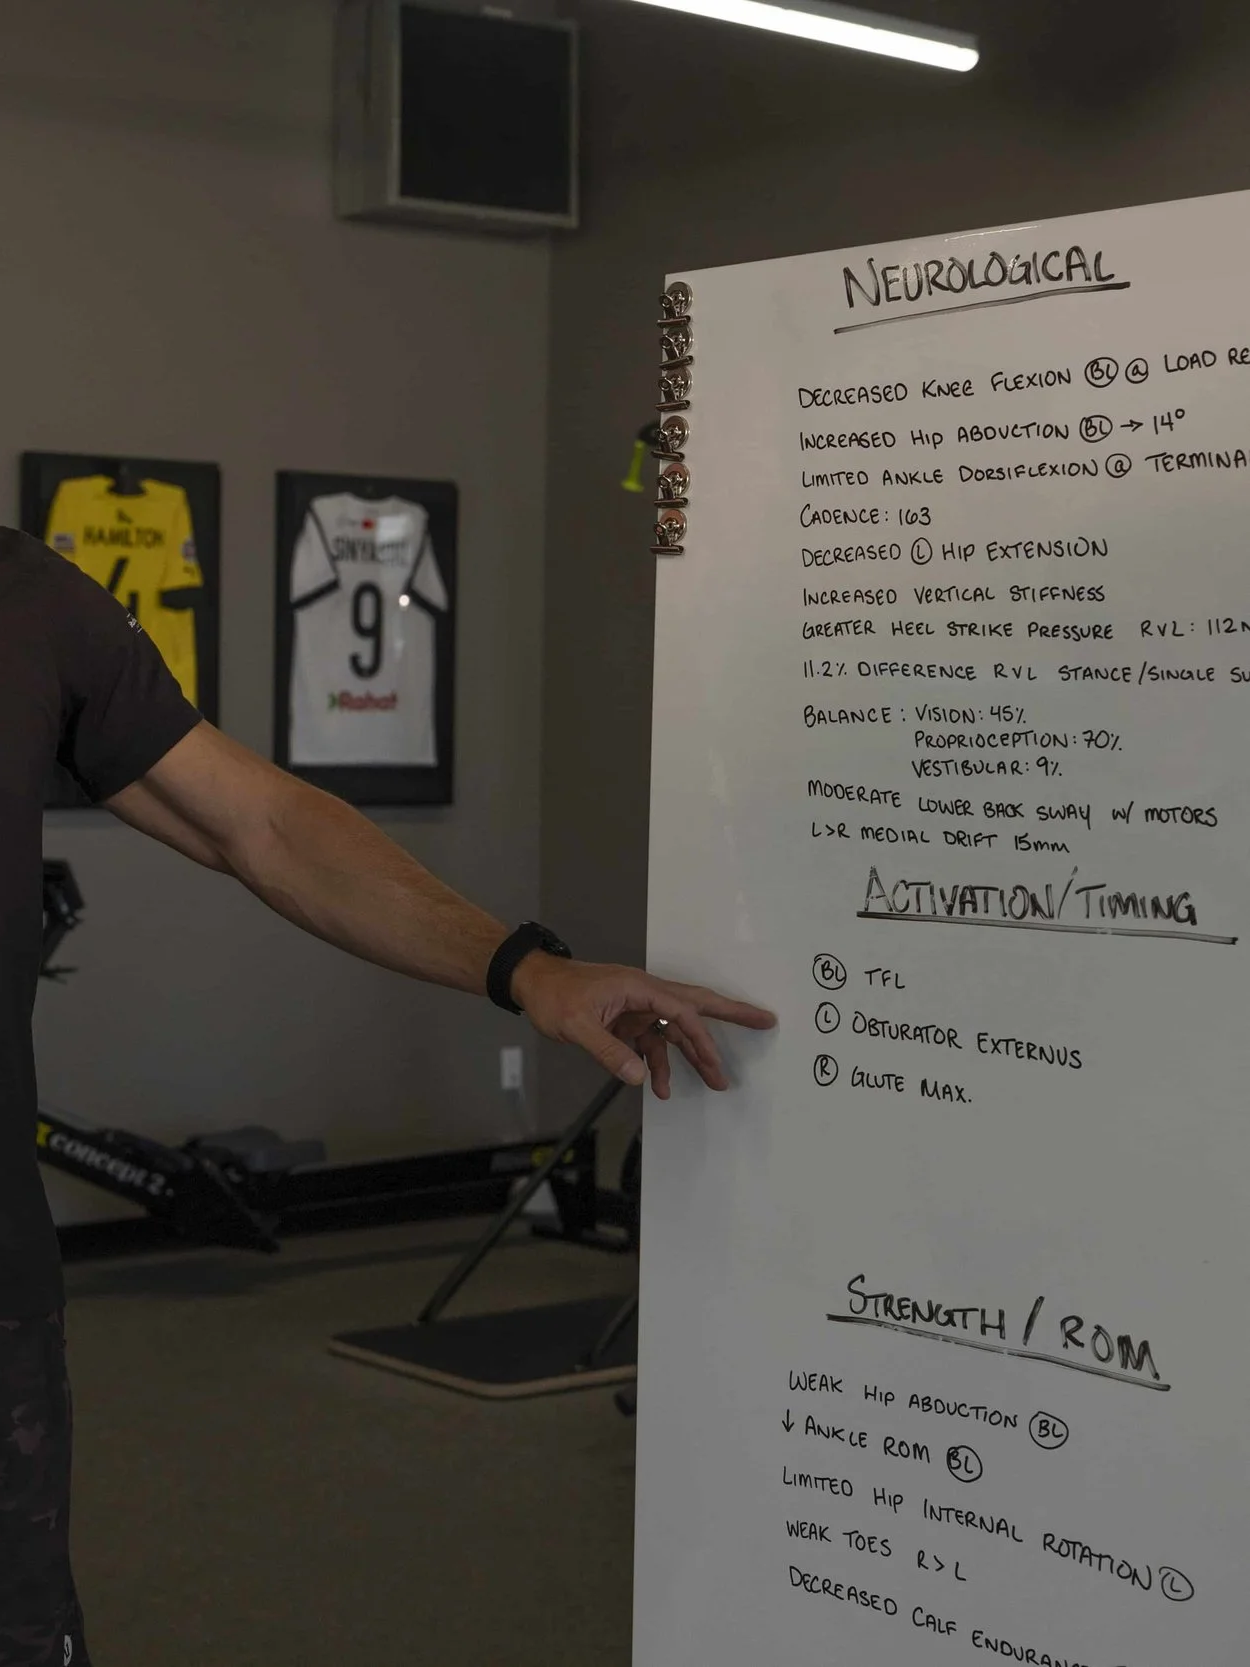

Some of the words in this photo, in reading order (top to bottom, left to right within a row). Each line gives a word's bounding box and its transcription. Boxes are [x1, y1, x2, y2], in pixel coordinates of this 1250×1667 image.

[843, 246, 1114, 308] NEUROLOGICAL
[797, 382, 909, 409] DECREASED
[921, 378, 975, 399] KNEE
[990, 367, 1072, 393] FLEXION
[1163, 349, 1218, 374] LOAD
[799, 431, 897, 452] INCREASED
[910, 428, 944, 451] HIP
[957, 421, 1070, 444] ABDUCTION
[801, 470, 869, 489] LIMITED
[882, 468, 944, 487] ANKLE
[957, 458, 1099, 483] DORSIFLEXION
[898, 506, 932, 527] 163
[82, 525, 165, 548] HAMILTON
[801, 542, 902, 568] DECREASED
[941, 541, 976, 563] HIP
[985, 536, 1109, 563] EXTENSION
[802, 587, 898, 607] INCREASED
[913, 585, 996, 605] VERTICAL
[1008, 584, 1106, 604] STIFFNESS
[349, 580, 382, 680] 9
[802, 618, 877, 640] GREATER
[890, 619, 936, 637] HEEL
[946, 620, 1013, 638] STRIKE
[1026, 621, 1114, 643] PRESSURE
[803, 659, 848, 679] 11.2%
[857, 660, 978, 682] DIFFERENCE
[807, 779, 902, 809] MODERATE
[918, 796, 975, 817] LOWER
[982, 800, 1025, 819] BACK
[1035, 803, 1092, 831] SWAY
[1111, 800, 1135, 825] w/
[1143, 805, 1219, 828] MOTORS
[860, 825, 931, 845] MEDIAL
[942, 829, 999, 849] DRIFT
[1013, 832, 1071, 854] 15mm
[863, 967, 906, 990] TFL
[851, 1010, 963, 1050] OBTURATOR
[976, 1031, 1083, 1070] EXTERNUS
[850, 1065, 905, 1093] GLUTE
[920, 1077, 973, 1104] MAX.
[847, 1274, 1006, 1340] STRENGTH
[1060, 1315, 1160, 1381] ROM
[788, 1369, 844, 1394] WEAK
[863, 1384, 896, 1408] HIP
[908, 1393, 1019, 1429] ABDUCTION
[804, 1414, 868, 1449] ANKLE
[883, 1435, 931, 1464] ROM
[782, 1465, 854, 1498] LIMITED
[873, 1487, 904, 1514] HIP
[923, 1497, 1024, 1543] INTERNAL
[1042, 1532, 1153, 1592] ROTATION
[785, 1519, 833, 1543] WEAK
[841, 1529, 893, 1558] TOES
[788, 1565, 898, 1616] DECREASED
[911, 1606, 958, 1636] CALF
